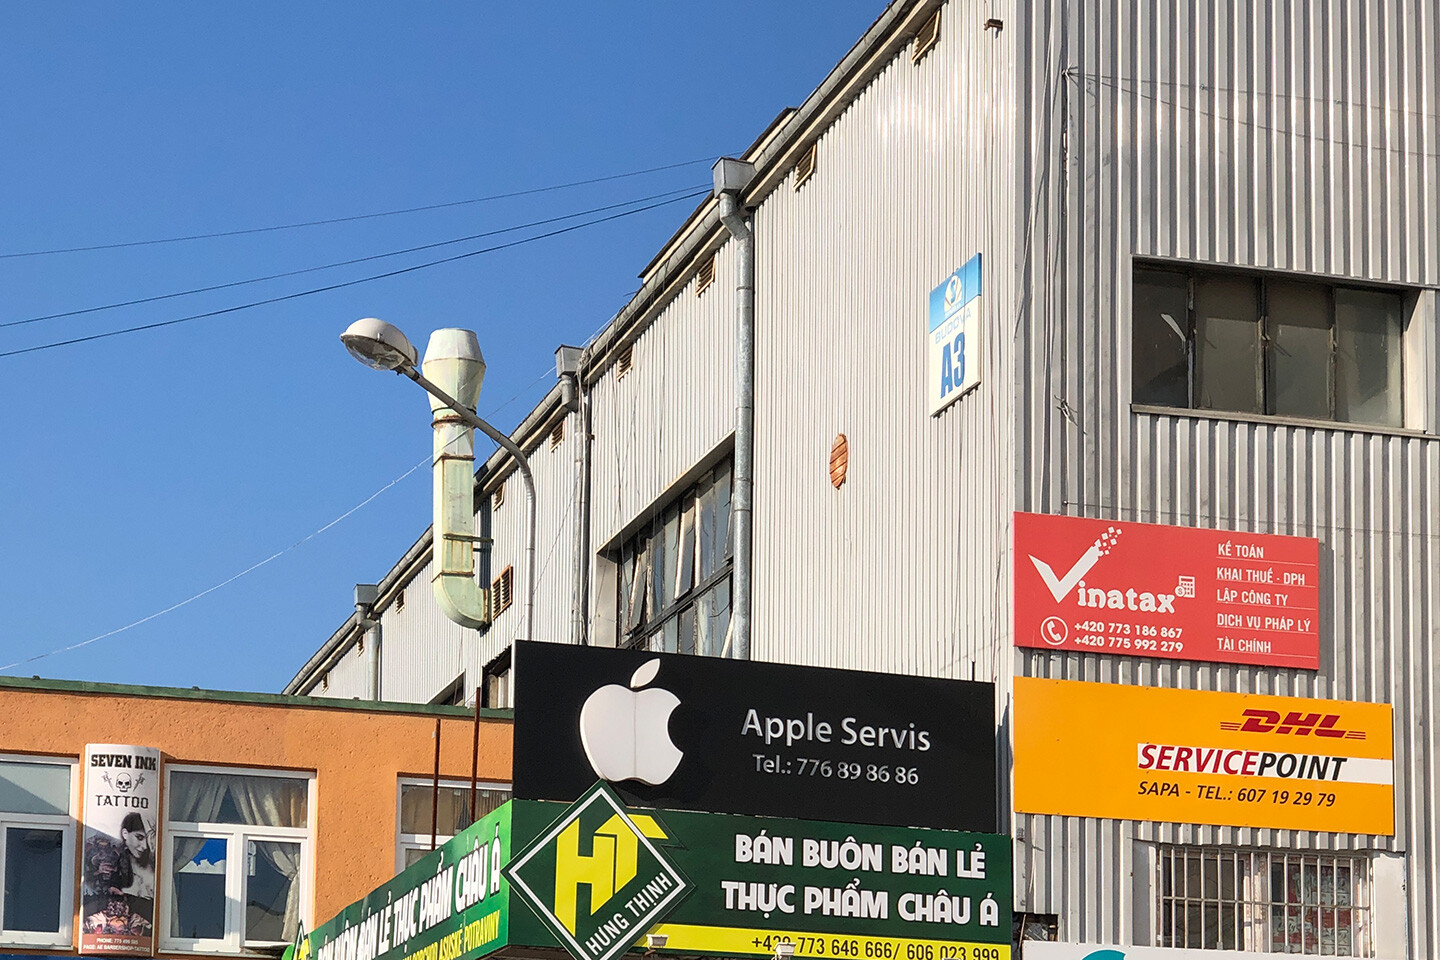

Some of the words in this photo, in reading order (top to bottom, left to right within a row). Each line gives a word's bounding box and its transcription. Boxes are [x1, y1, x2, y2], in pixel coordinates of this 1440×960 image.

[940, 331, 965, 399] A3
[1218, 540, 1232, 556] KẾ
[1235, 544, 1264, 559] TOÁN
[1216, 567, 1242, 581] KHAI
[1246, 567, 1273, 583] THUẾ
[1283, 572, 1305, 586] DPH
[1216, 587, 1238, 604] LẬP
[1241, 589, 1271, 605] CÔNG
[1274, 593, 1288, 606] TY
[1074, 620, 1105, 632] +420
[1108, 622, 1131, 635] 773
[1135, 624, 1157, 637] 186
[1160, 627, 1183, 639] 867
[1217, 613, 1242, 628] DỊCH
[1246, 615, 1261, 630] VỤ
[1265, 616, 1294, 631] PHÁP
[1297, 618, 1311, 632] LÝ
[1216, 636, 1234, 650] TÀI
[1238, 638, 1271, 653] CHÍNH
[741, 708, 832, 747] Apple
[840, 717, 931, 752] Servis
[1241, 708, 1348, 740] DHL
[90, 754, 131, 770] SEVEN
[135, 755, 157, 771] INK
[752, 753, 792, 775] Tel.:
[796, 758, 833, 778] 776
[837, 761, 861, 780] 89
[865, 764, 890, 783] 86
[894, 766, 919, 785] 86
[1138, 744, 1348, 781] SERVICEPOINT
[95, 795, 149, 809] TATTOO
[1138, 781, 1180, 797] SAPA
[1196, 784, 1233, 801] TEL.:
[1237, 788, 1266, 803] 607
[1272, 790, 1290, 805] 19
[1293, 791, 1312, 806] 29
[1316, 792, 1336, 808] 79
[735, 829, 794, 866] BÁN
[802, 836, 882, 872] BUÔN
[891, 841, 947, 877] BÁN
[956, 843, 986, 879] LẺ
[585, 912, 630, 956] HƯNG
[624, 872, 673, 918] THỊNH
[721, 881, 795, 919] THỰC
[804, 878, 889, 920] PHẨM
[898, 889, 971, 925] CHÂU
[979, 892, 999, 927] Á
[797, 936, 825, 955] 773
[831, 939, 859, 957] 646
[865, 941, 901, 960] 666/
